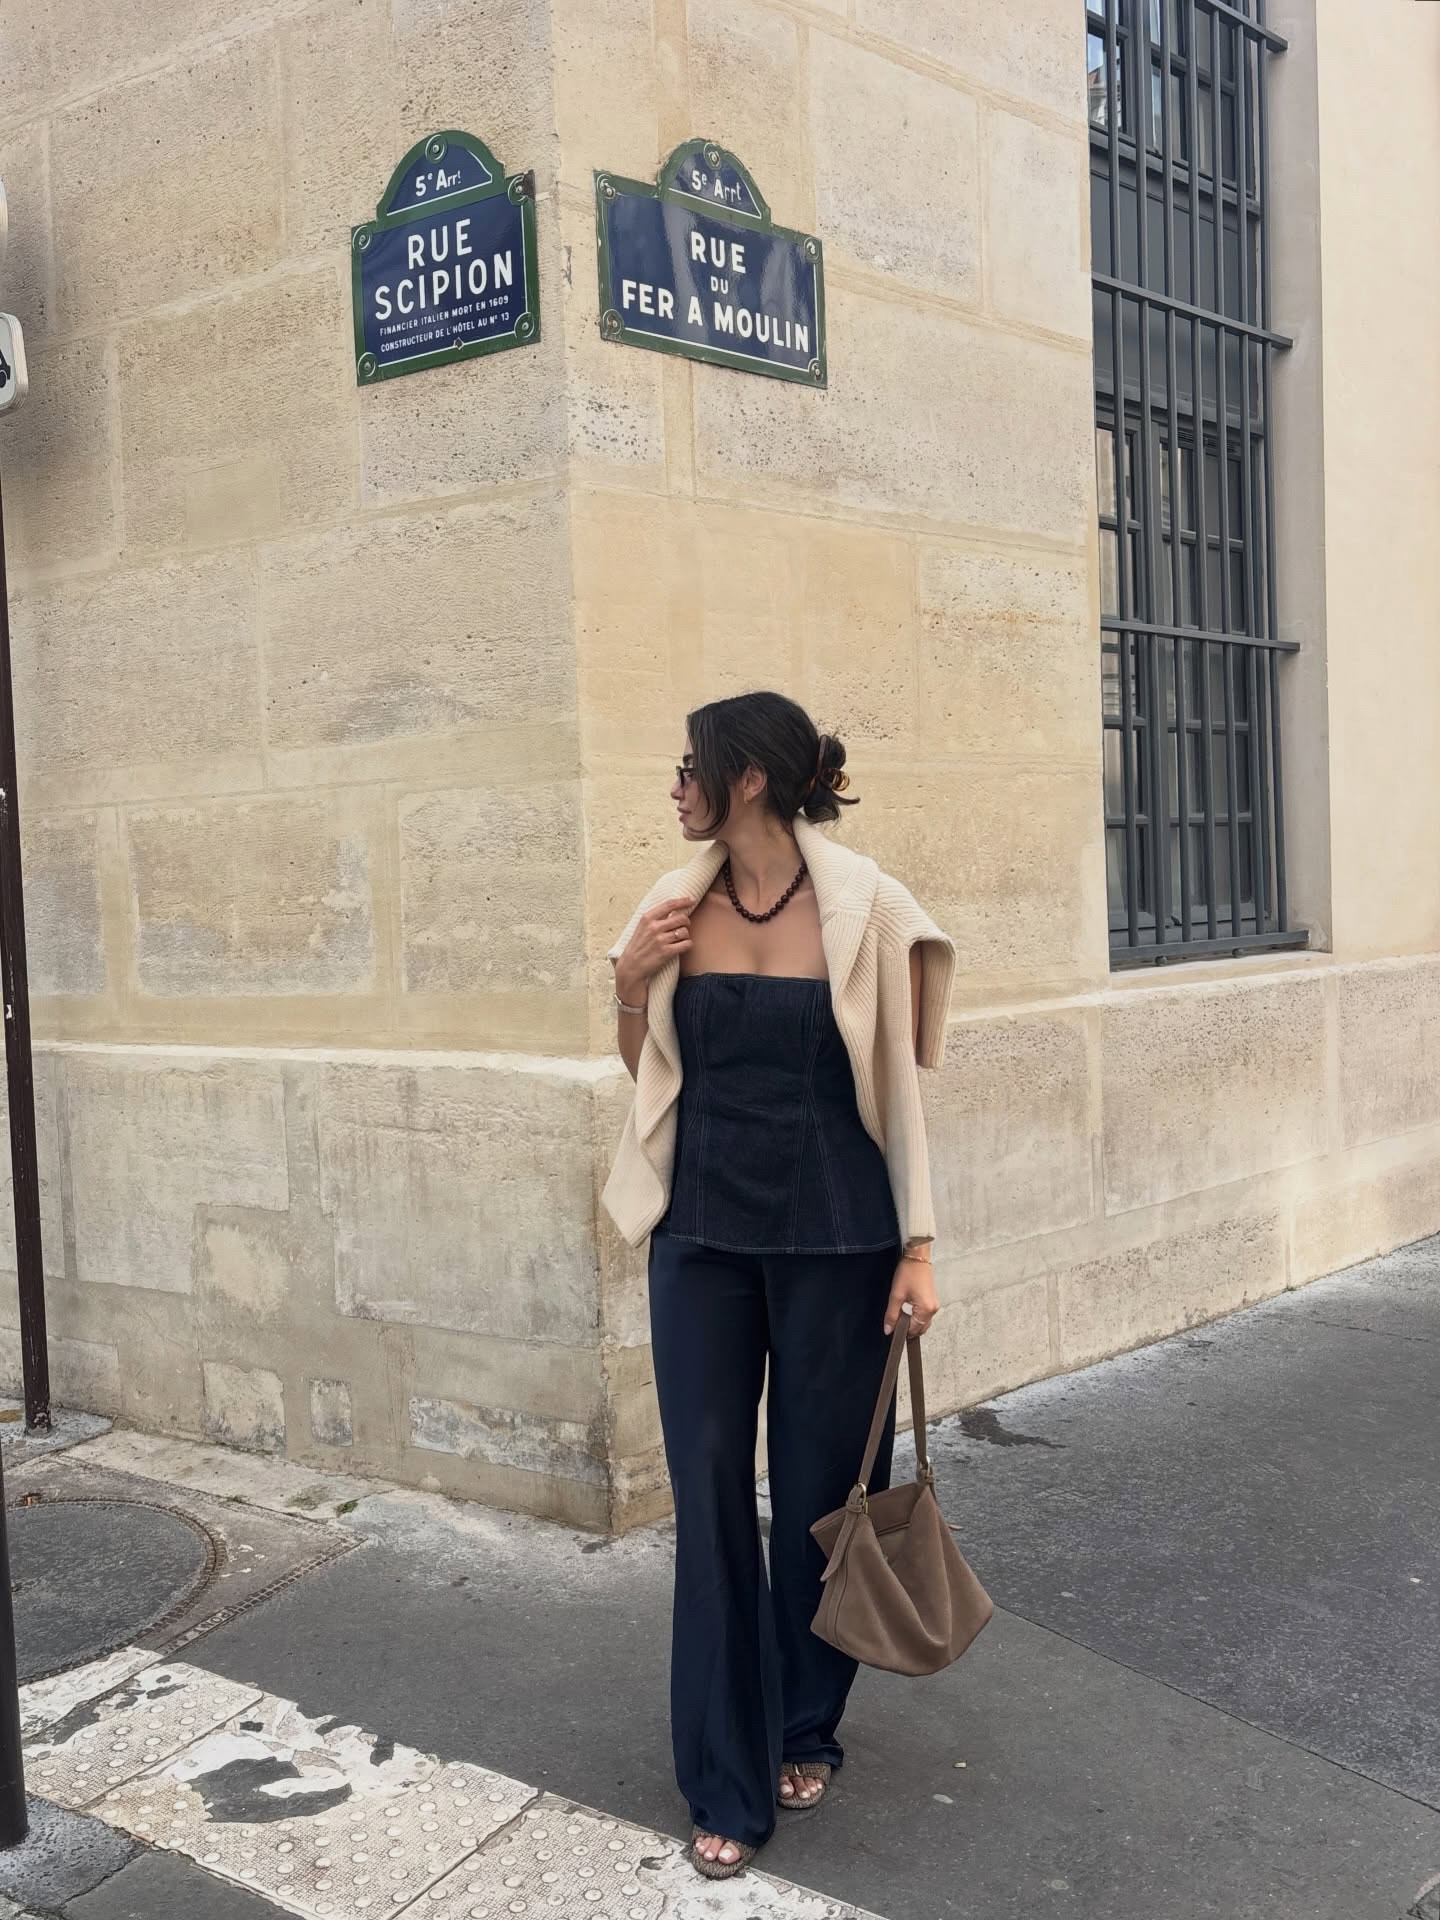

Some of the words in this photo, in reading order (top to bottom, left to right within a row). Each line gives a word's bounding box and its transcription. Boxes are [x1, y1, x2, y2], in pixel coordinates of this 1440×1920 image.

[407, 218, 473, 270] RUE
[690, 231, 746, 274] RUE
[375, 250, 513, 321] SCIPION
[710, 276, 729, 295] DU
[379, 319, 419, 337] FINANCIER
[421, 311, 449, 326] ITALIEN
[451, 304, 473, 317] MORT
[475, 301, 486, 311] EN
[488, 295, 509, 308] 1609
[380, 331, 433, 353] CONSTRUCTEUR
[435, 328, 444, 339] DE
[477, 317, 488, 327] AU
[500, 311, 510, 321] 13
[622, 279, 674, 320] FER
[687, 296, 703, 326] A
[714, 302, 809, 353] MOULIN
